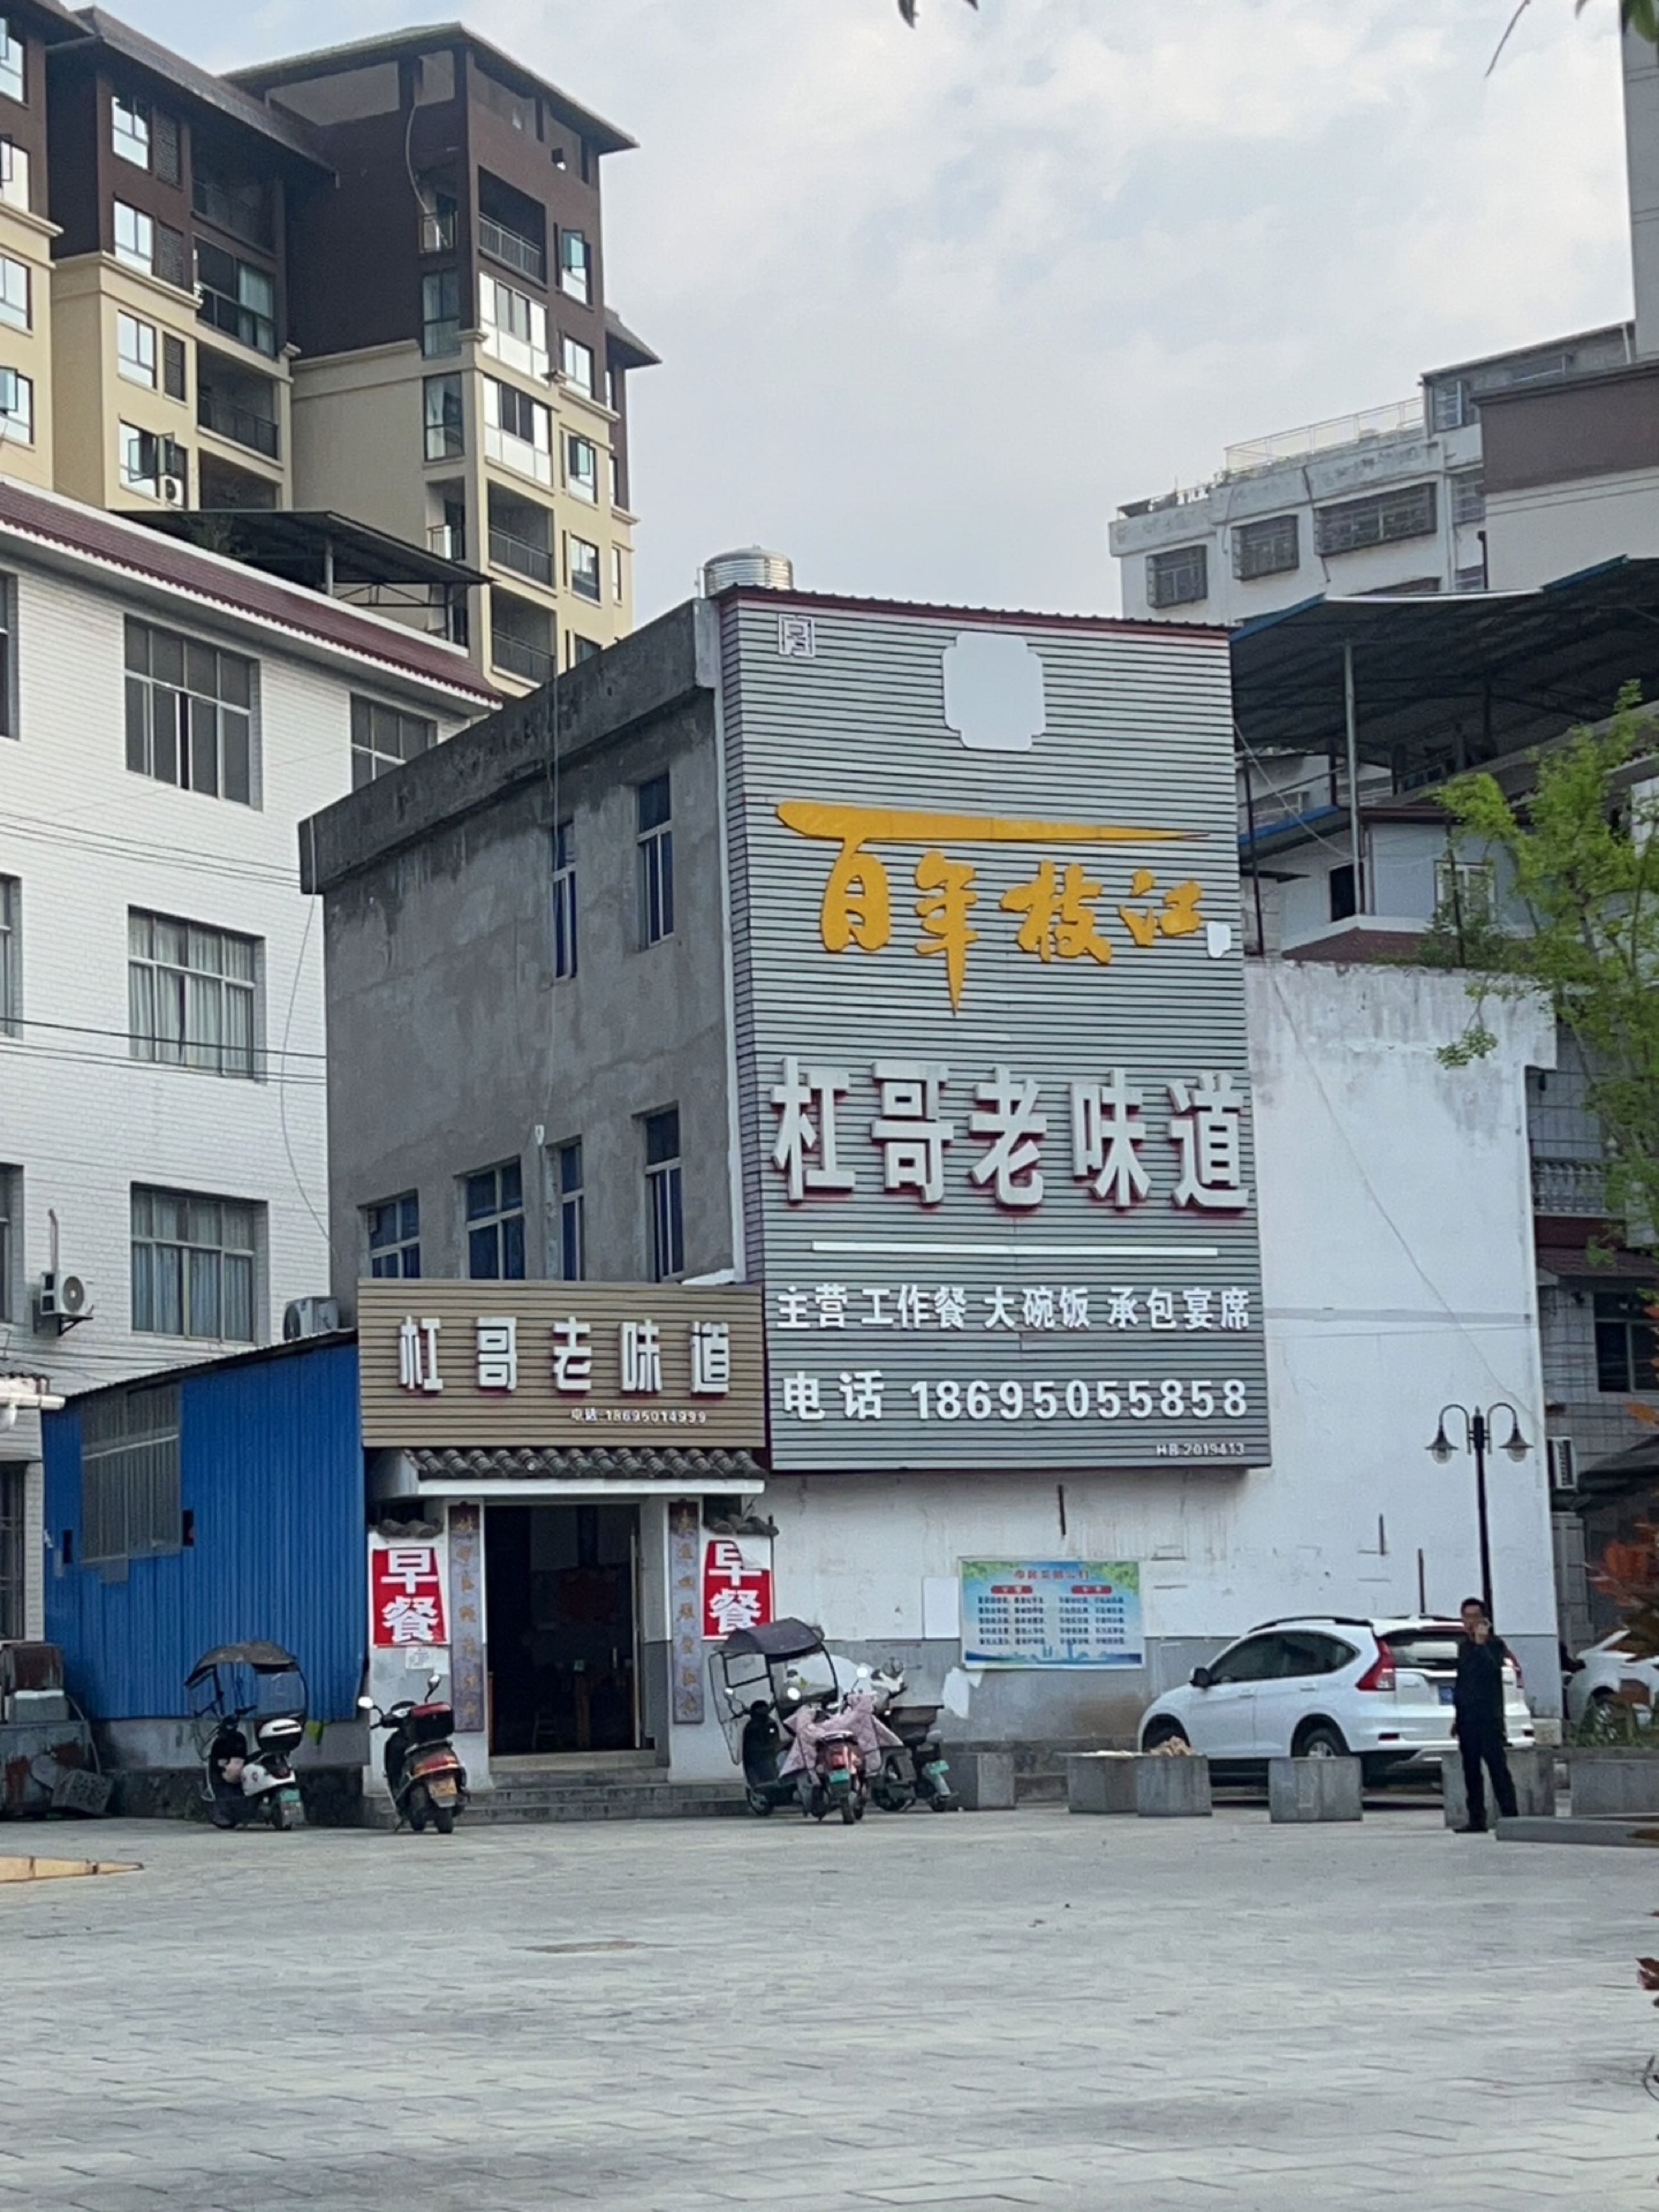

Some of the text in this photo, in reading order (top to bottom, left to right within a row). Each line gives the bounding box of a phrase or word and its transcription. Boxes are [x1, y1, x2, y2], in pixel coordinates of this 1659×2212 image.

[775, 801, 1210, 1018] 百年枝江
[770, 1056, 1249, 1208] 杜哥老味道
[398, 1315, 730, 1393] 杜哥老味道
[783, 1370, 1247, 1420] 电话 18695055858
[380, 1549, 439, 1643] 早餐
[709, 1543, 762, 1634] 早餐
